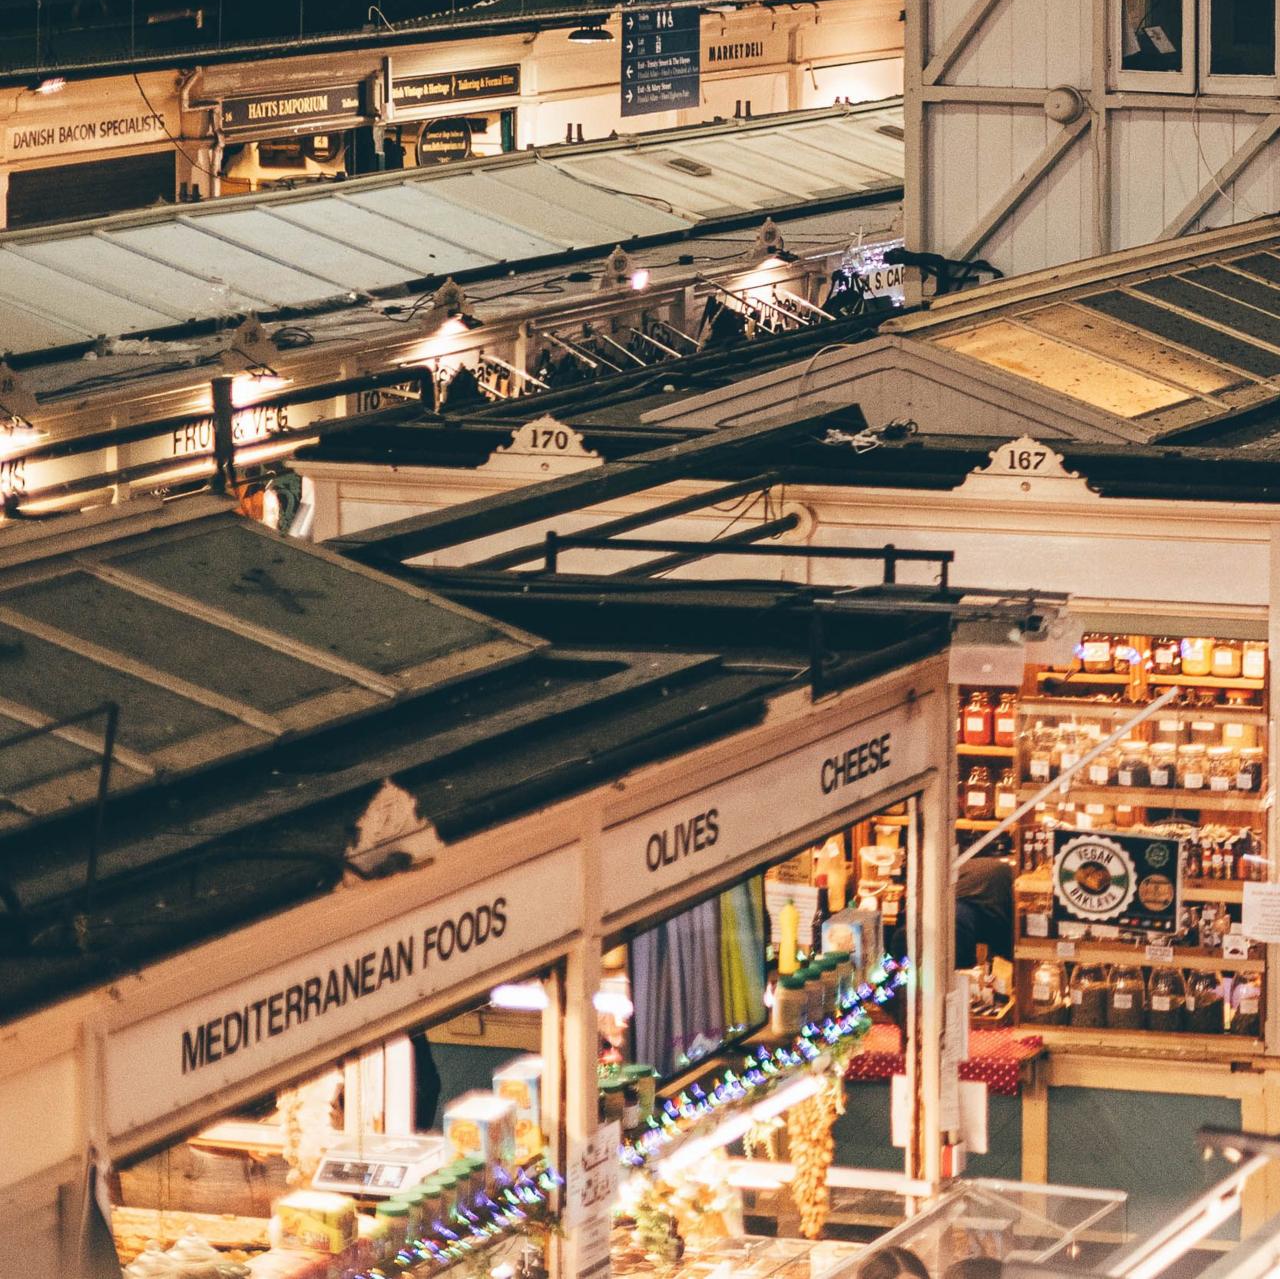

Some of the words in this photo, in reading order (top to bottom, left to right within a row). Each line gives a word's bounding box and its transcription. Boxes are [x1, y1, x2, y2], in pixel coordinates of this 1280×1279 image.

[708, 41, 743, 62] MARKET
[745, 41, 763, 59] DELI
[248, 101, 279, 119] HATTS
[279, 95, 328, 116] EMPORIUM
[14, 128, 55, 149] DANISH
[59, 123, 96, 143] BACON
[100, 114, 165, 138] SPECIALISTS
[233, 422, 244, 440] &
[254, 406, 288, 436] VEG
[531, 429, 568, 450] 170
[1008, 450, 1046, 470] 167
[820, 732, 892, 795] CHEESE
[645, 807, 719, 872] OLIVES
[1077, 847, 1113, 864] VEGAN
[181, 934, 414, 1074] MEDITERRANEAN
[421, 896, 507, 971] FOODS
